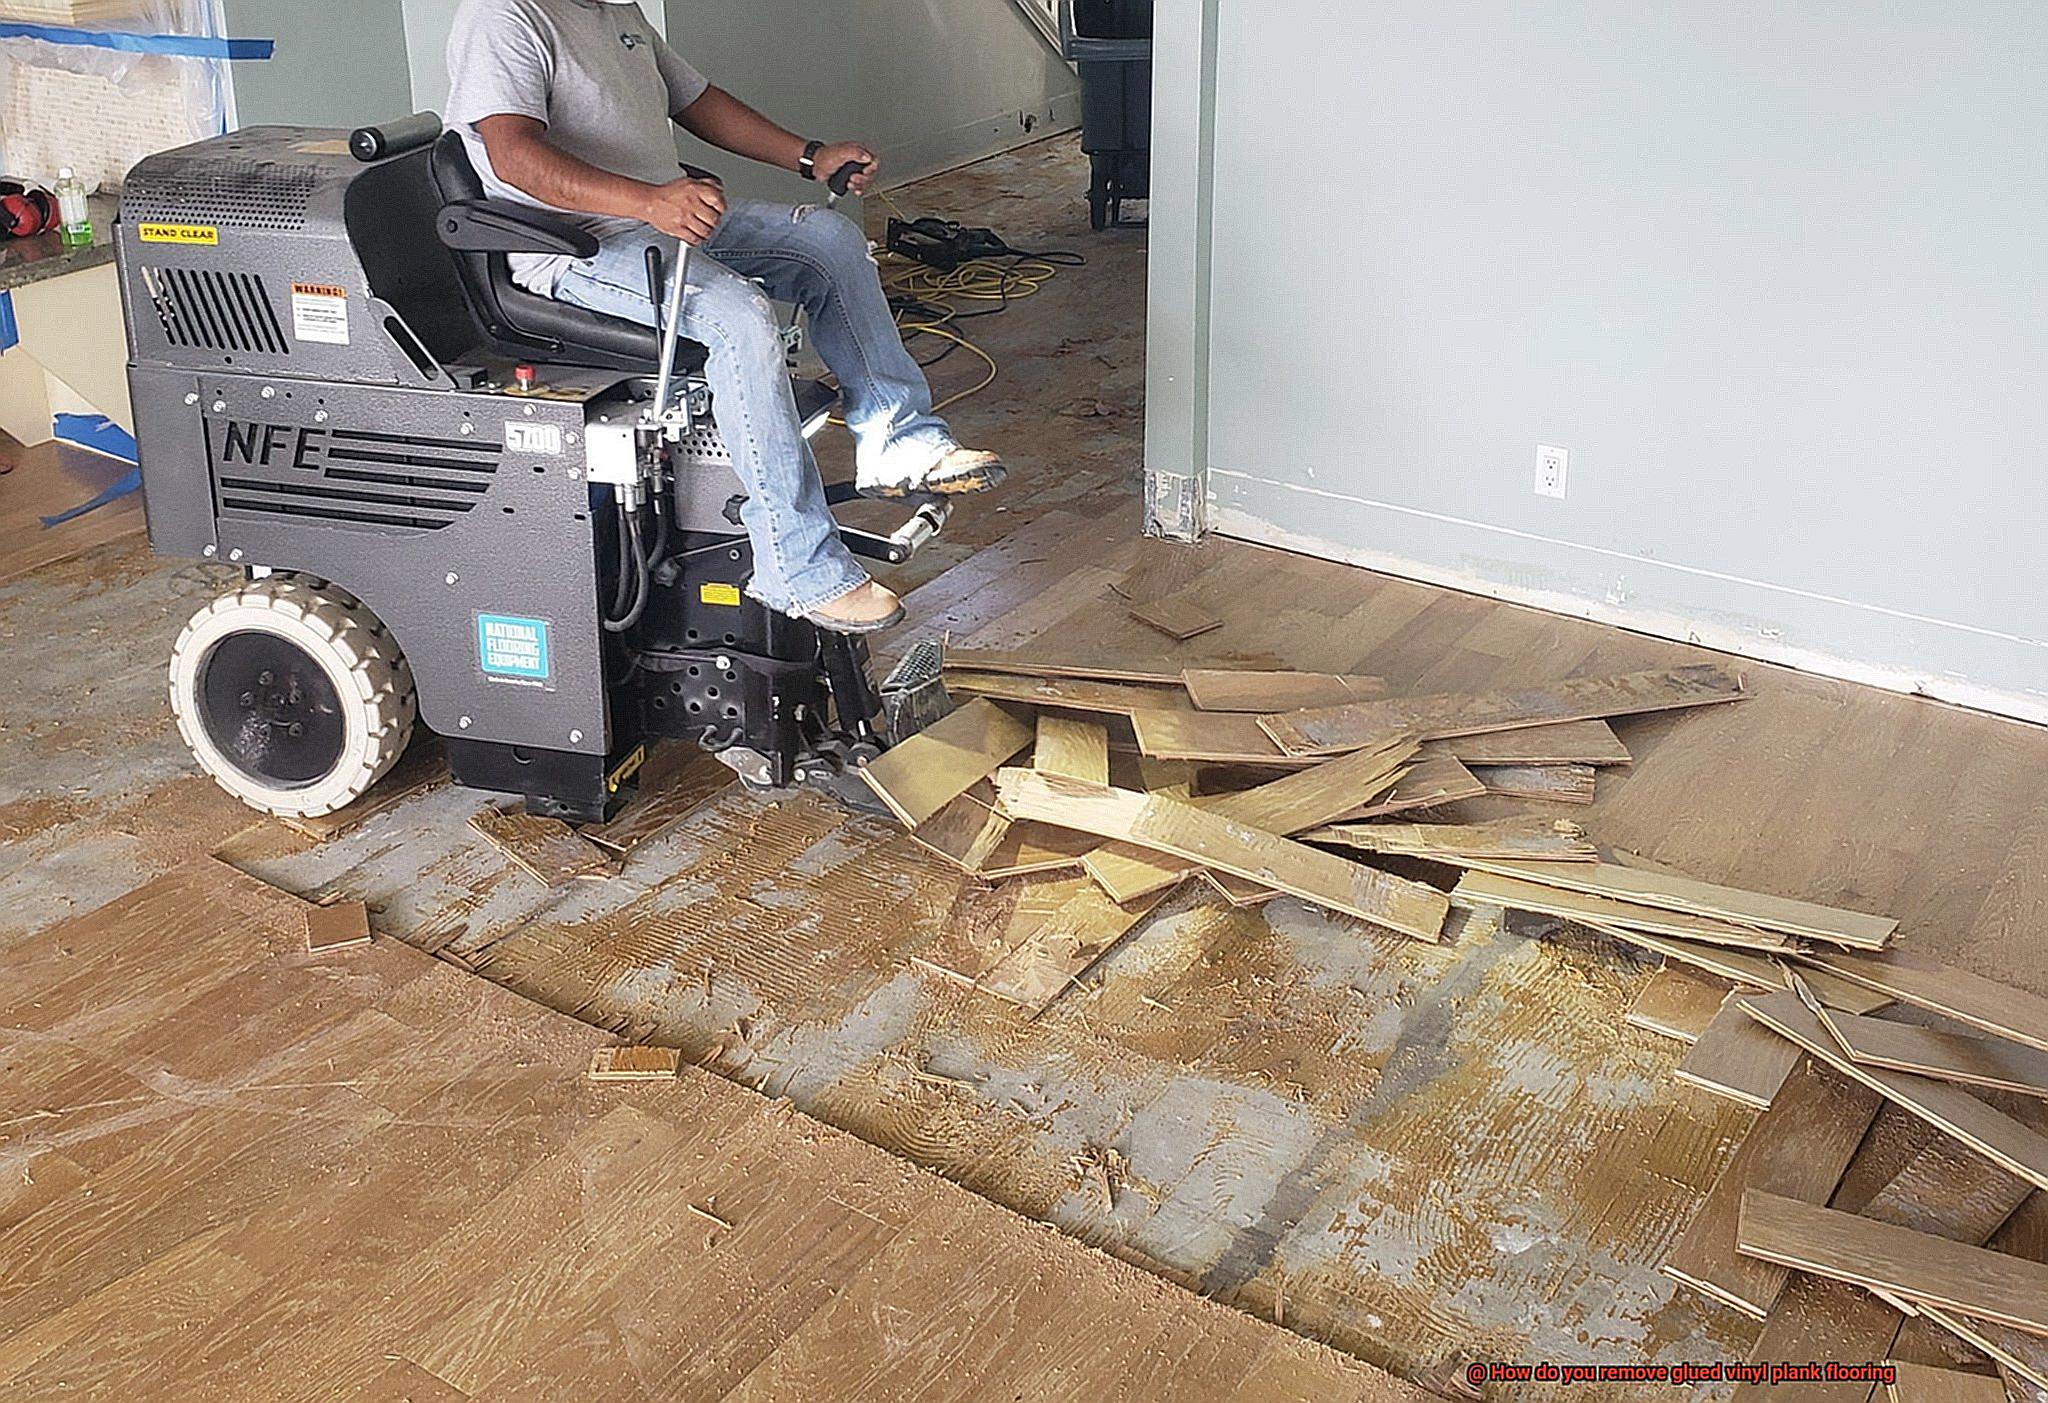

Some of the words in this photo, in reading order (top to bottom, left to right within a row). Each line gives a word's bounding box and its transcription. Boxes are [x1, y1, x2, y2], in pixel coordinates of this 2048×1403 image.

[143, 227, 178, 238] STAND
[180, 228, 215, 240] CLEAR
[294, 284, 345, 297] WARNING!
[223, 421, 327, 471] NFE
[507, 422, 561, 455] 5700
[487, 653, 541, 671] EQUIPMENT
